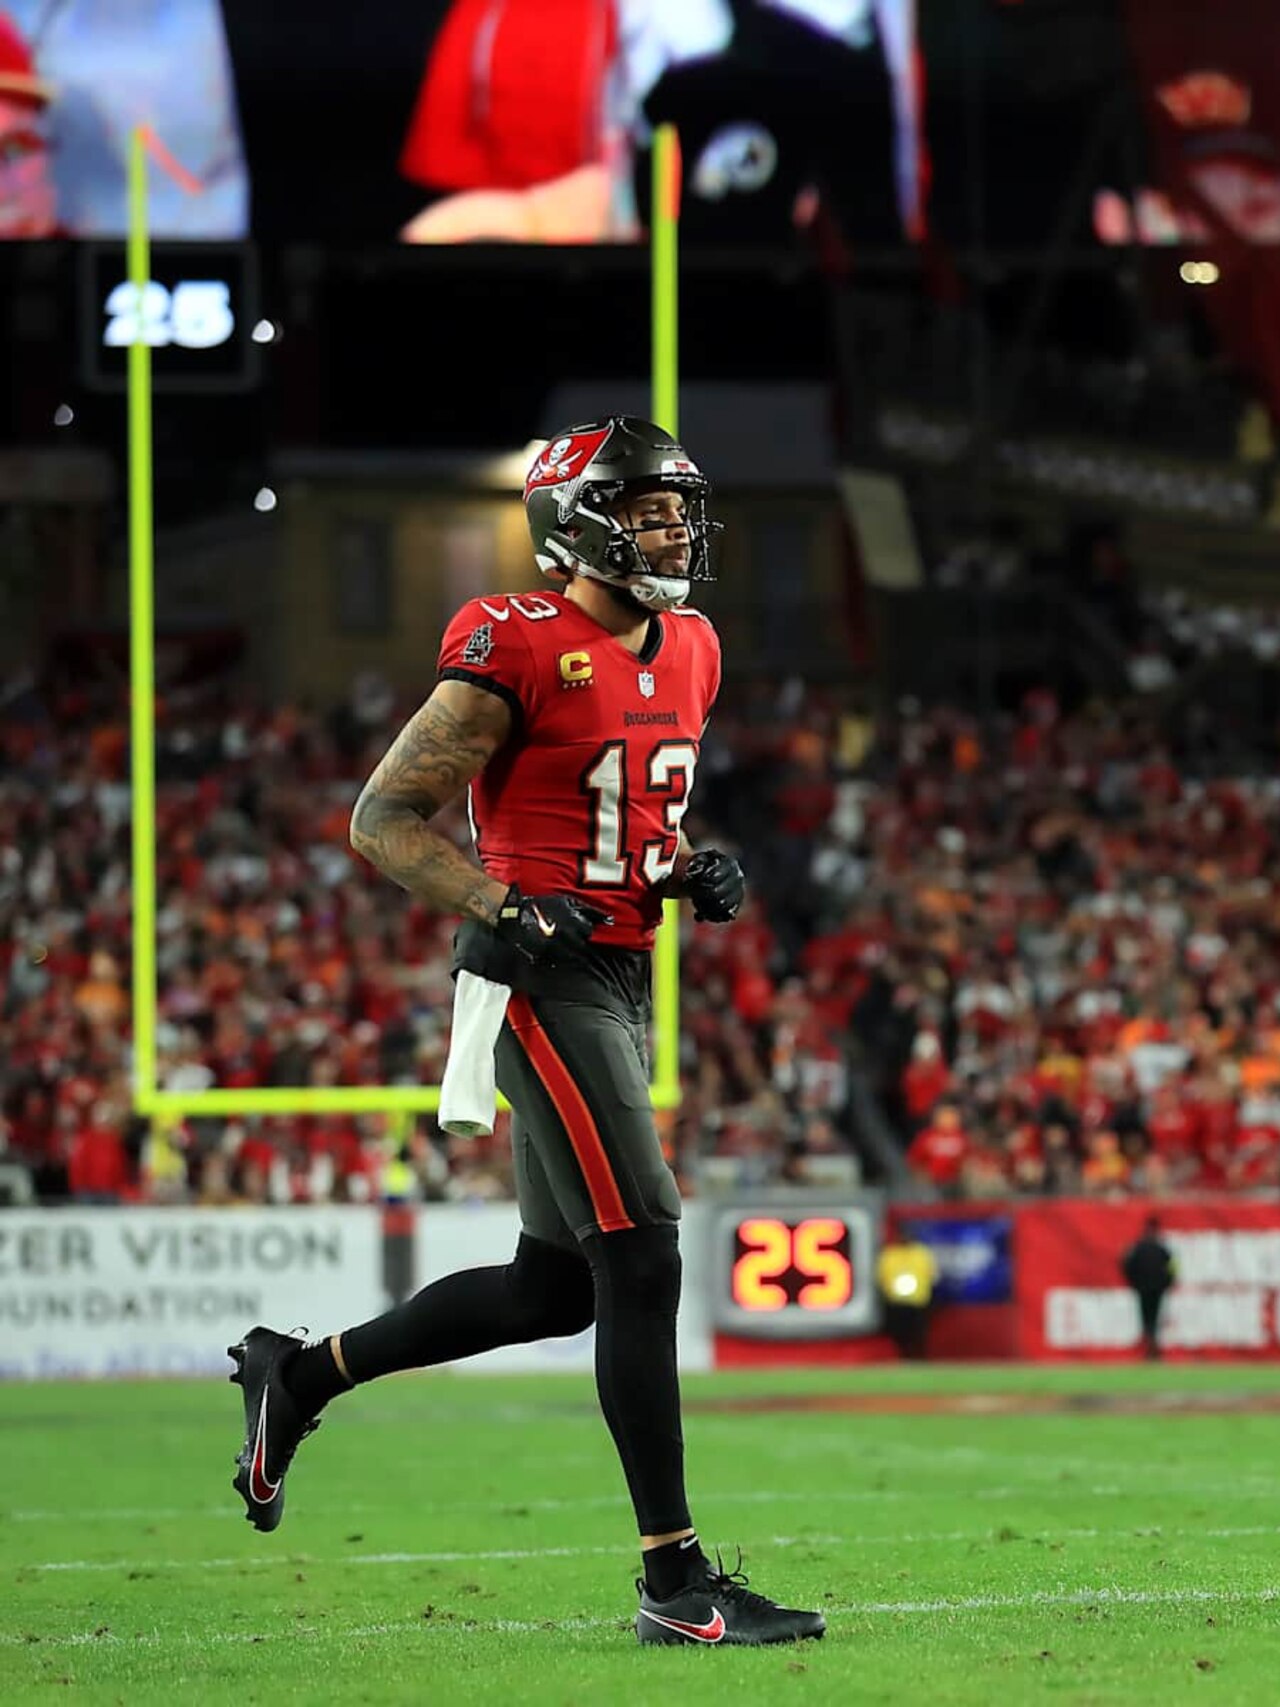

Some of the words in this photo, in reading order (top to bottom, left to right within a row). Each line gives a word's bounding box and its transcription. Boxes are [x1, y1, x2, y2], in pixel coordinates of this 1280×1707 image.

[103, 279, 235, 348] 25
[559, 651, 593, 681] C
[579, 739, 700, 889] 13
[0, 1224, 95, 1274] ER
[121, 1224, 343, 1272] VISION
[732, 1218, 853, 1312] 25
[0, 1289, 260, 1328] UNDATION
